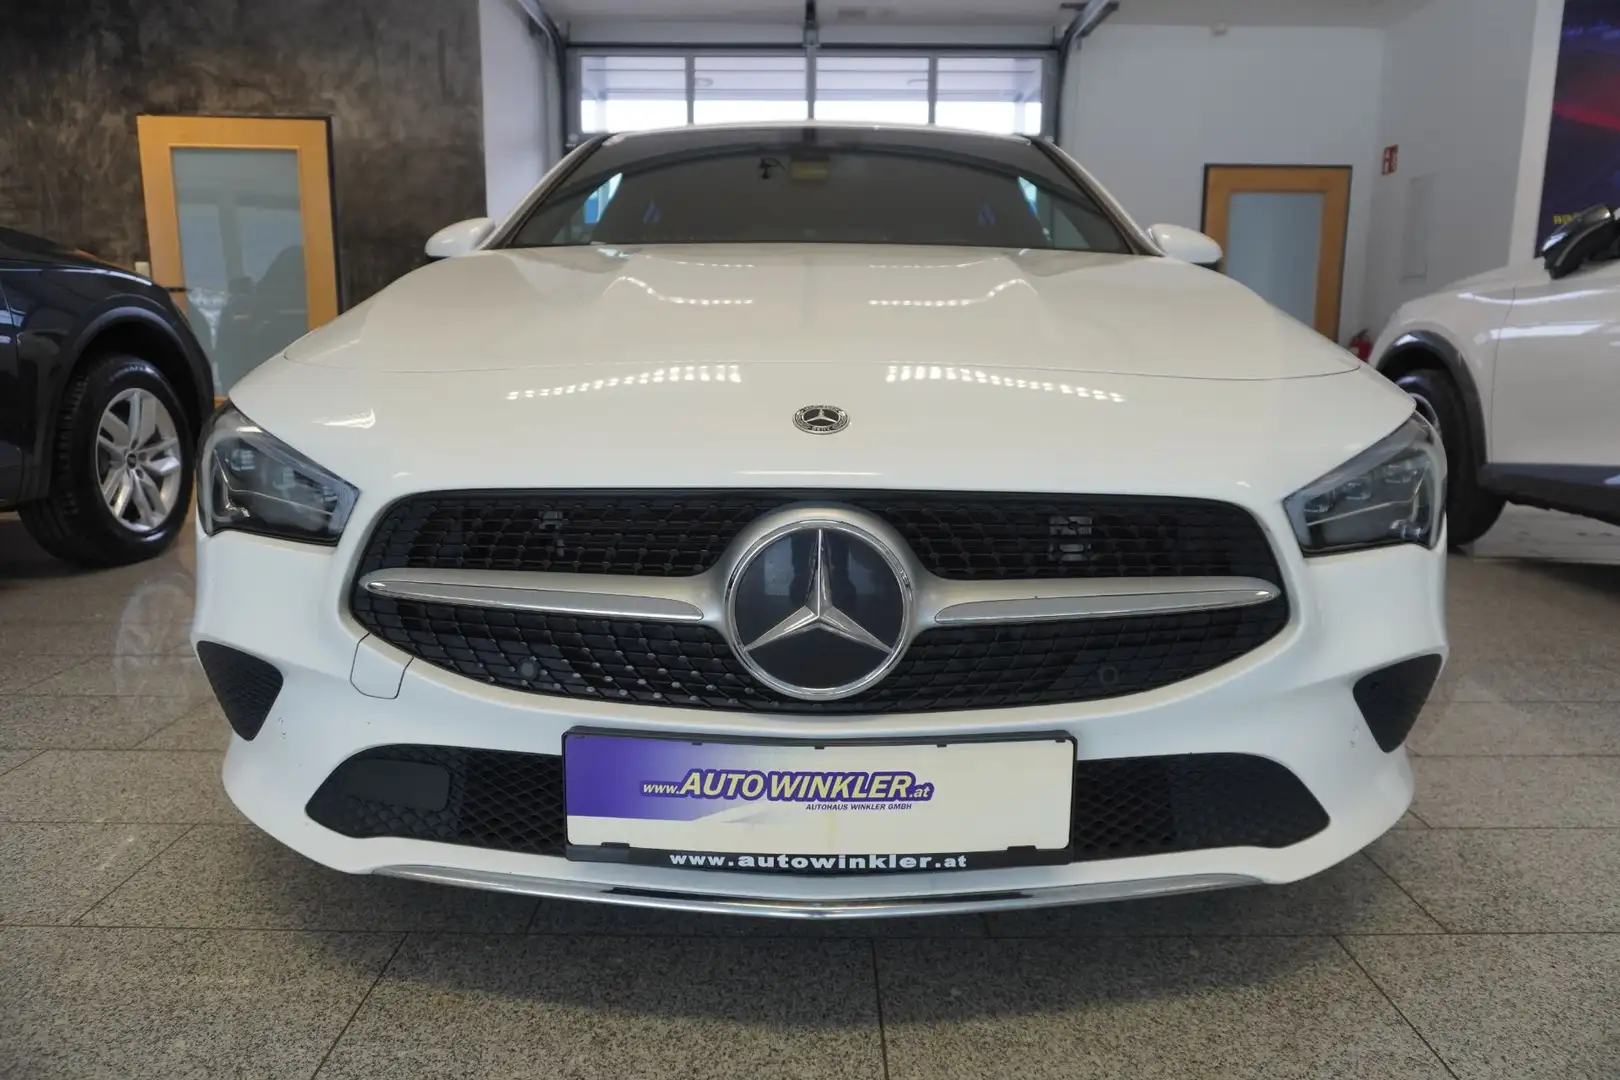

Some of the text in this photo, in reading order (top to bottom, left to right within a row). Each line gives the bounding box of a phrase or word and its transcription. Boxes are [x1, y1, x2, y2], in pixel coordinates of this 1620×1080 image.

[805, 802, 912, 811] AUTOHAUS WINKLER GMBH
[669, 853, 967, 869] www.autowinkler.at
